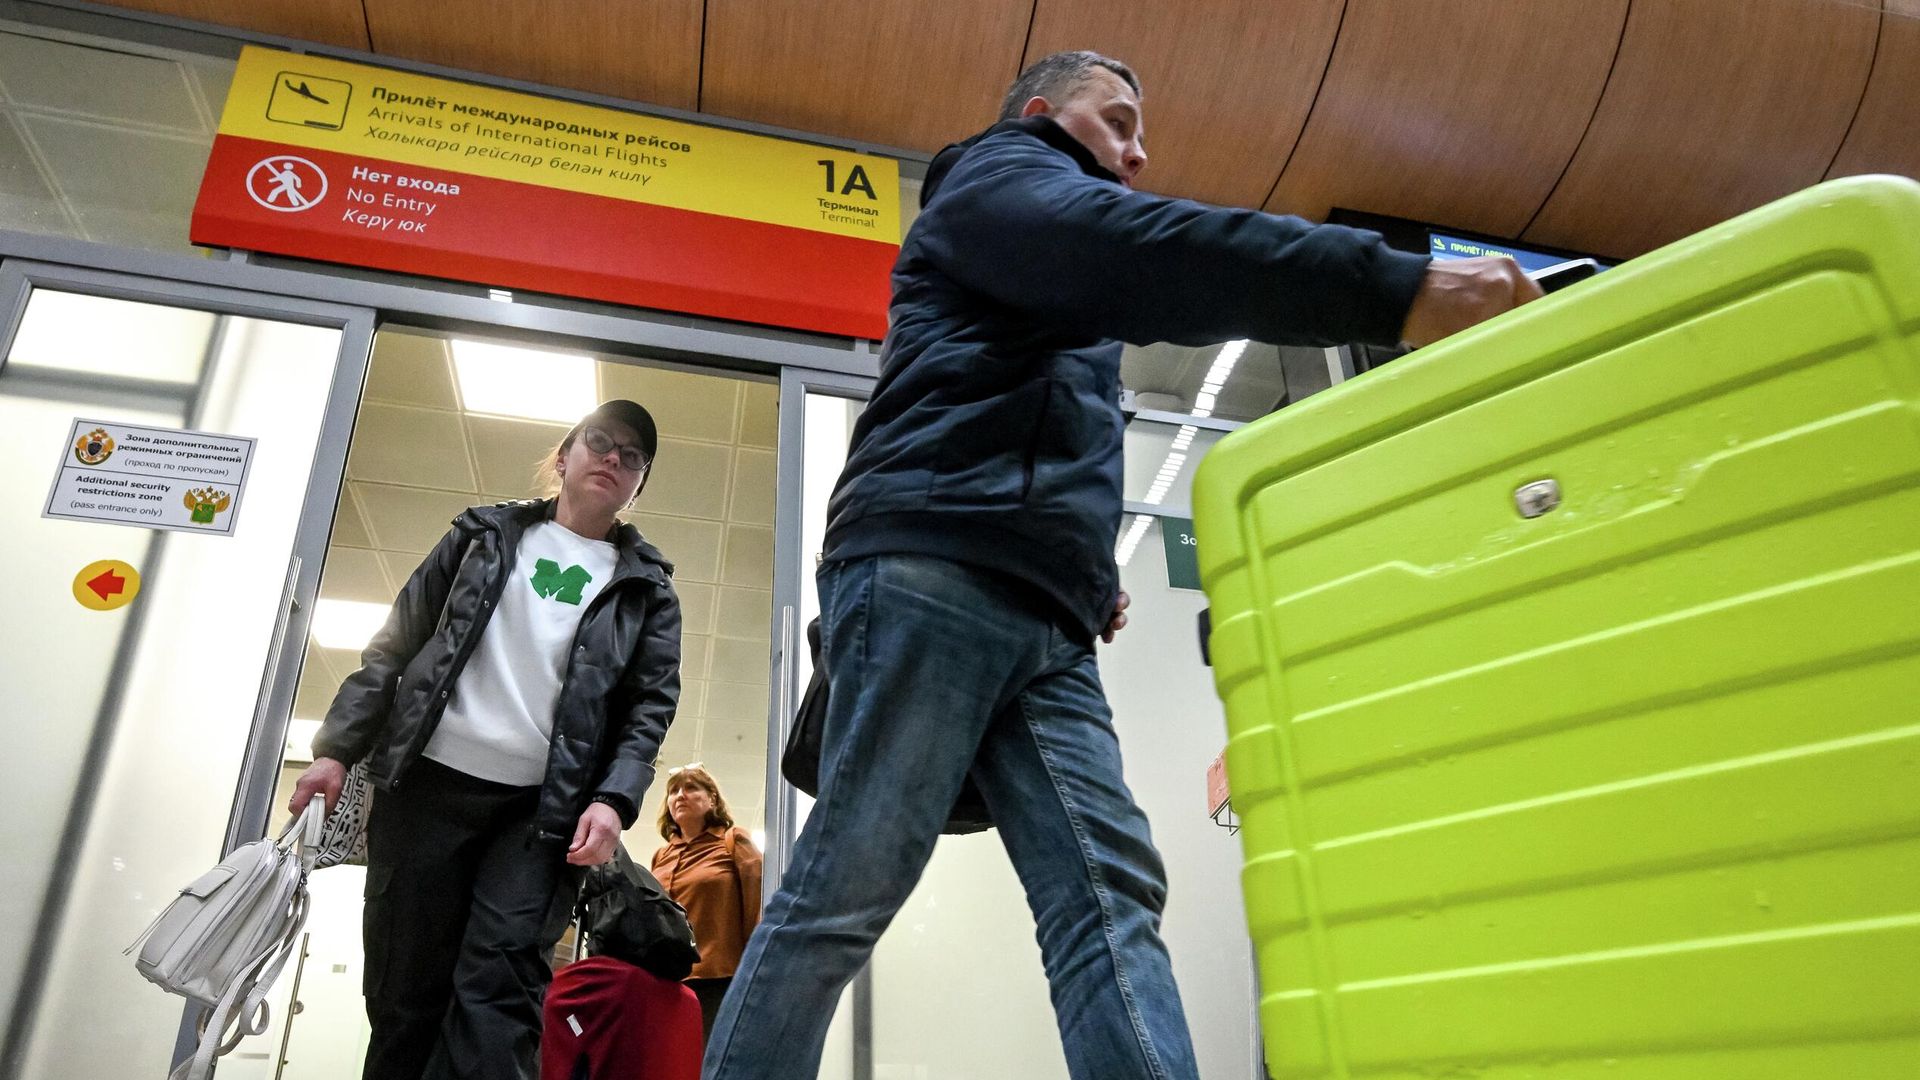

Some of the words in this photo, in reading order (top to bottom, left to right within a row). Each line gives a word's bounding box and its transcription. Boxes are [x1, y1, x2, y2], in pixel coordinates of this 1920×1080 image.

[372, 87, 447, 110] Прилёт
[453, 103, 619, 141] международных
[625, 133, 691, 153] рейсов
[364, 126, 461, 152] Халыкара
[465, 145, 543, 168] рейслар
[368, 107, 443, 130] Arrivals
[450, 122, 470, 134] of
[476, 125, 598, 157] International
[605, 146, 667, 168] Flights
[352, 166, 392, 184] Нет
[396, 176, 460, 195] входа
[817, 160, 878, 200] 1A
[347, 187, 375, 204] No
[383, 193, 436, 216] Entry
[817, 198, 879, 216] Терминал
[397, 220, 427, 233] юк
[821, 210, 875, 228] Terminal
[1450, 243, 1480, 255] ПРИЛЁТ
[125, 434, 151, 443] Зона
[152, 438, 240, 453] дополнительных
[117, 444, 173, 456] режимных
[175, 450, 242, 463] ограничений
[124, 459, 161, 470] (проход
[177, 464, 229, 477] пропускам)
[75, 475, 128, 487] Additional
[130, 481, 171, 493] security
[77, 487, 136, 499] restrictions
[138, 493, 163, 502] zone
[70, 500, 96, 510] (pass
[97, 502, 138, 514] entrance
[139, 507, 163, 518] only)
[530, 558, 593, 606] M
